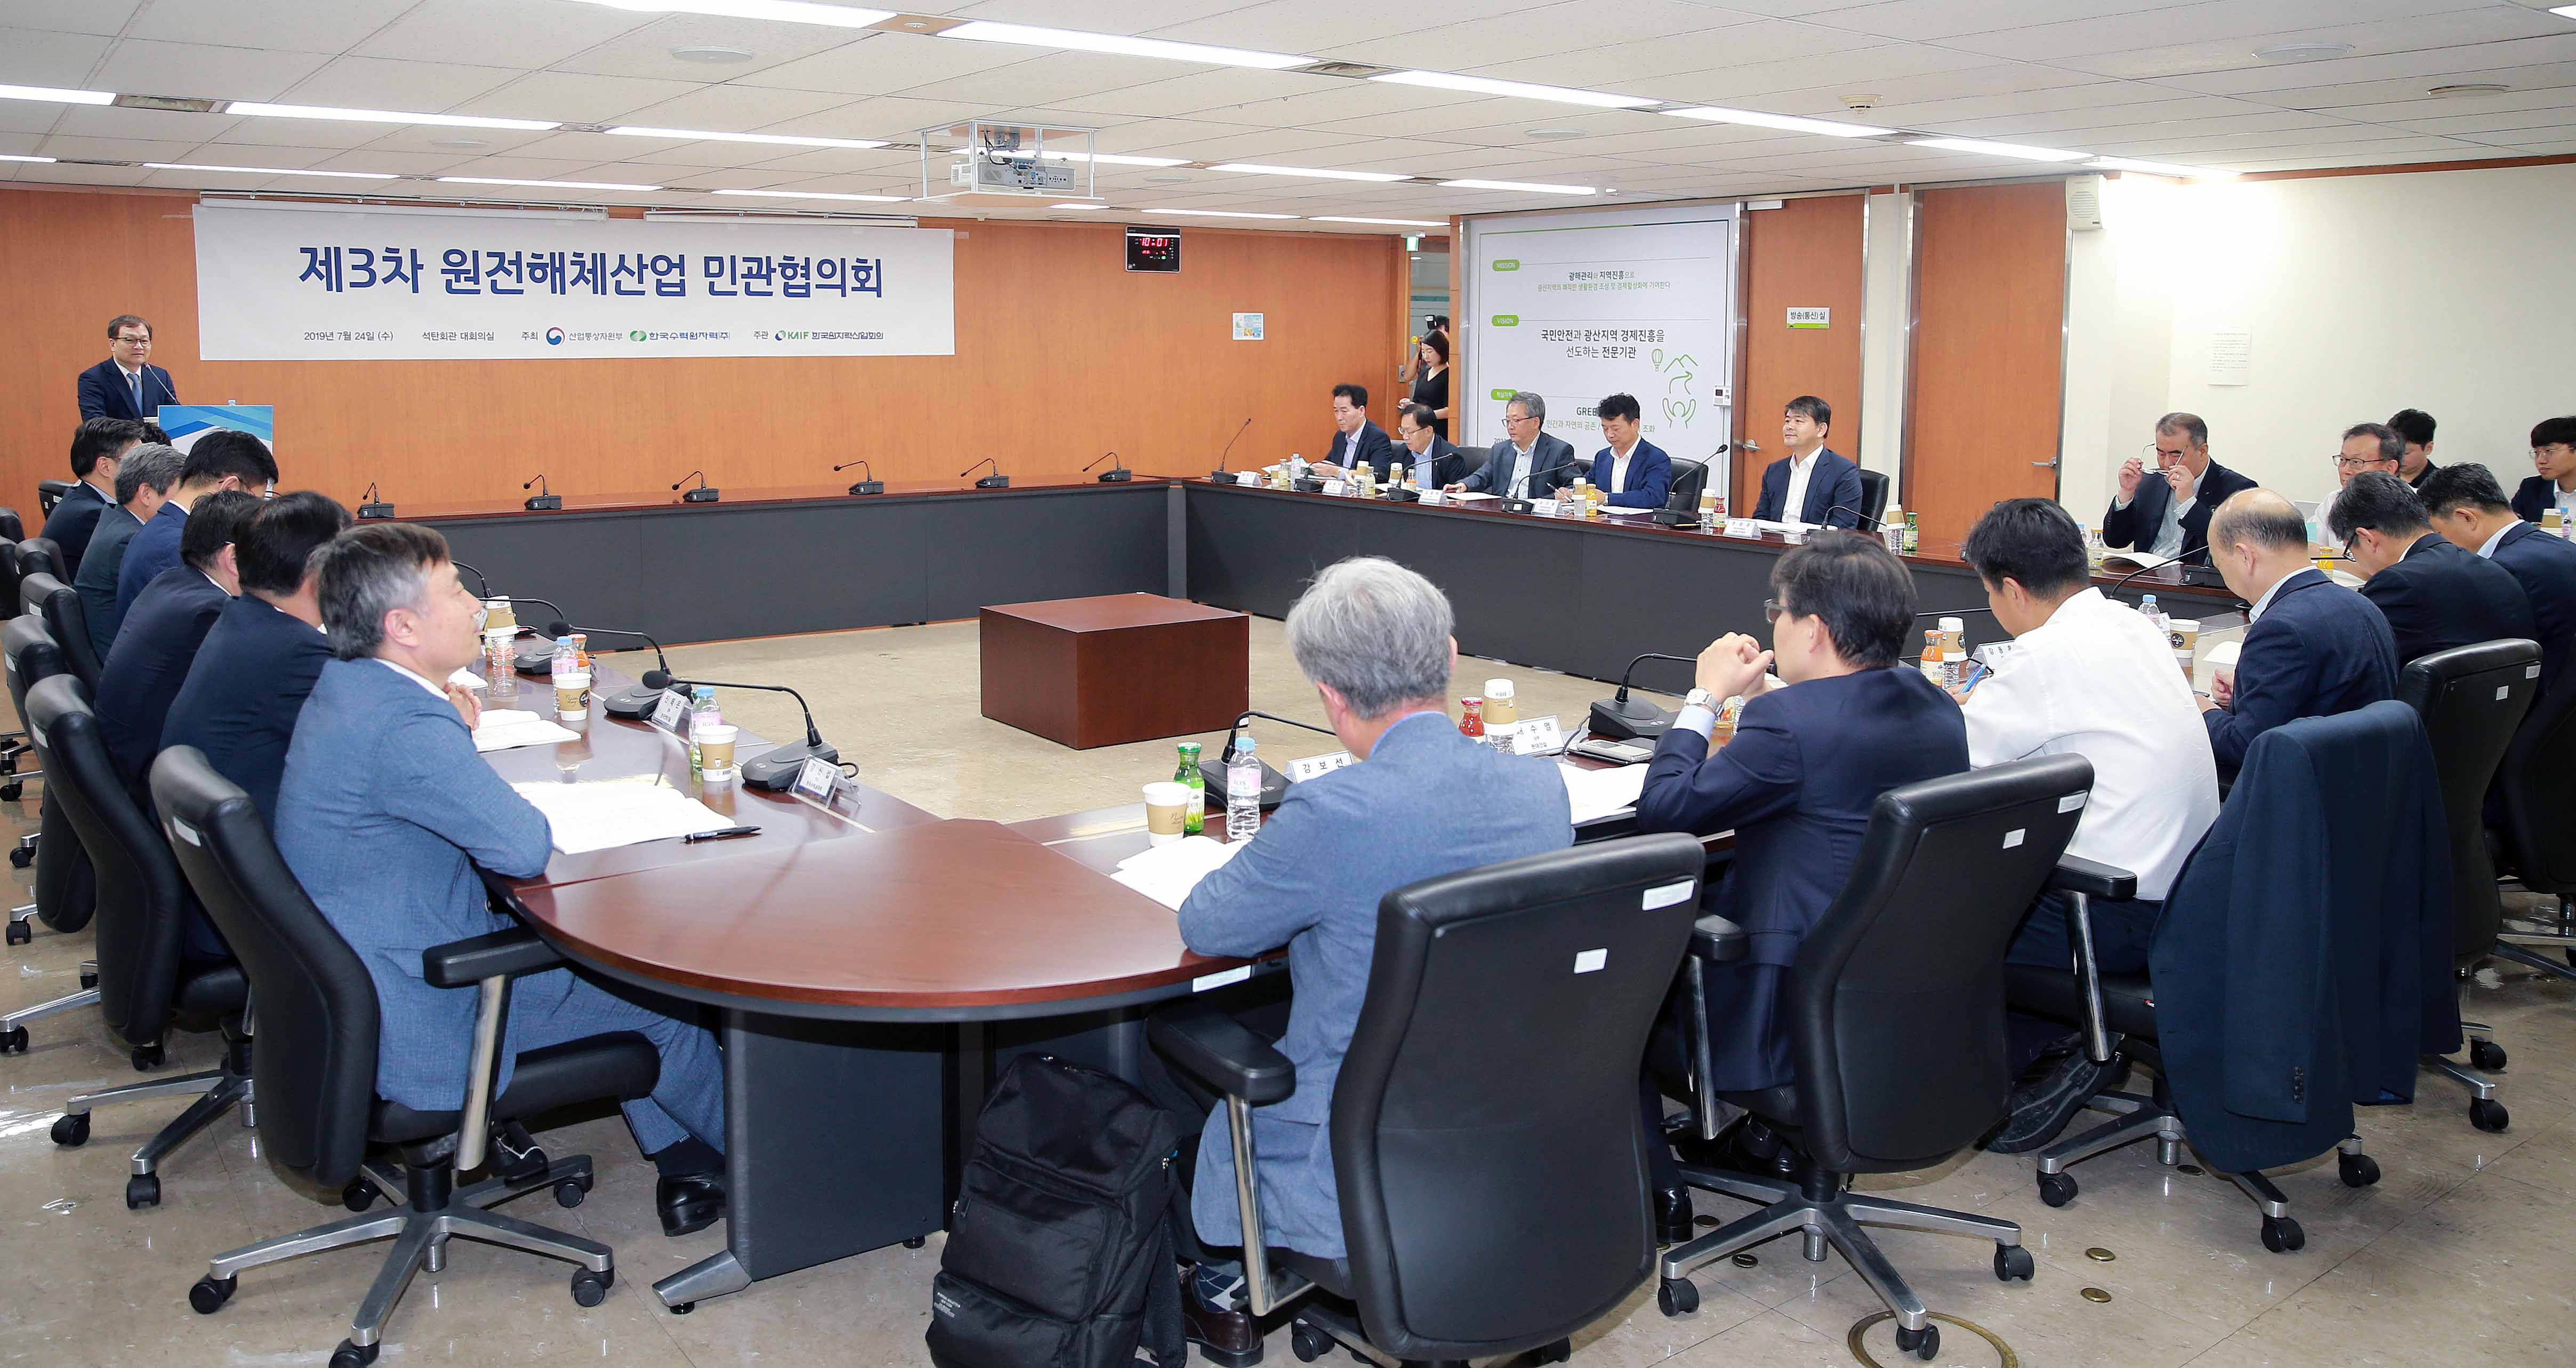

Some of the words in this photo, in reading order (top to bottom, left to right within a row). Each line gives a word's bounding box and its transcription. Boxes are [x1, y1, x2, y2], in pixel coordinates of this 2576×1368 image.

[1142, 238, 1168, 247] 10:01
[299, 246, 424, 293] 제3차
[440, 249, 687, 296] 원전해체산업
[704, 255, 883, 299] 민관협의회
[1599, 282, 1609, 291] 조성
[304, 331, 334, 341] 2019년
[337, 331, 351, 341] 7월
[355, 331, 375, 341] 24일
[378, 331, 393, 341] (수)
[422, 331, 457, 341] 석탄회관
[460, 331, 495, 341] 대회의실
[521, 332, 538, 341] 주최
[569, 332, 623, 341] 산업통상자원부
[753, 331, 769, 340] 주관
[1541, 329, 1581, 342] 국민안전과
[1584, 329, 1617, 342] 광산지역
[1621, 329, 1665, 343] 경제진흥을
[1566, 346, 1599, 358] 선도하는
[1602, 347, 1637, 359] 전문기관
[1576, 407, 1597, 416] GREE
[1547, 419, 1564, 429] 인간과
[1565, 420, 1582, 429] 자연의
[1584, 421, 1596, 431] 공존
